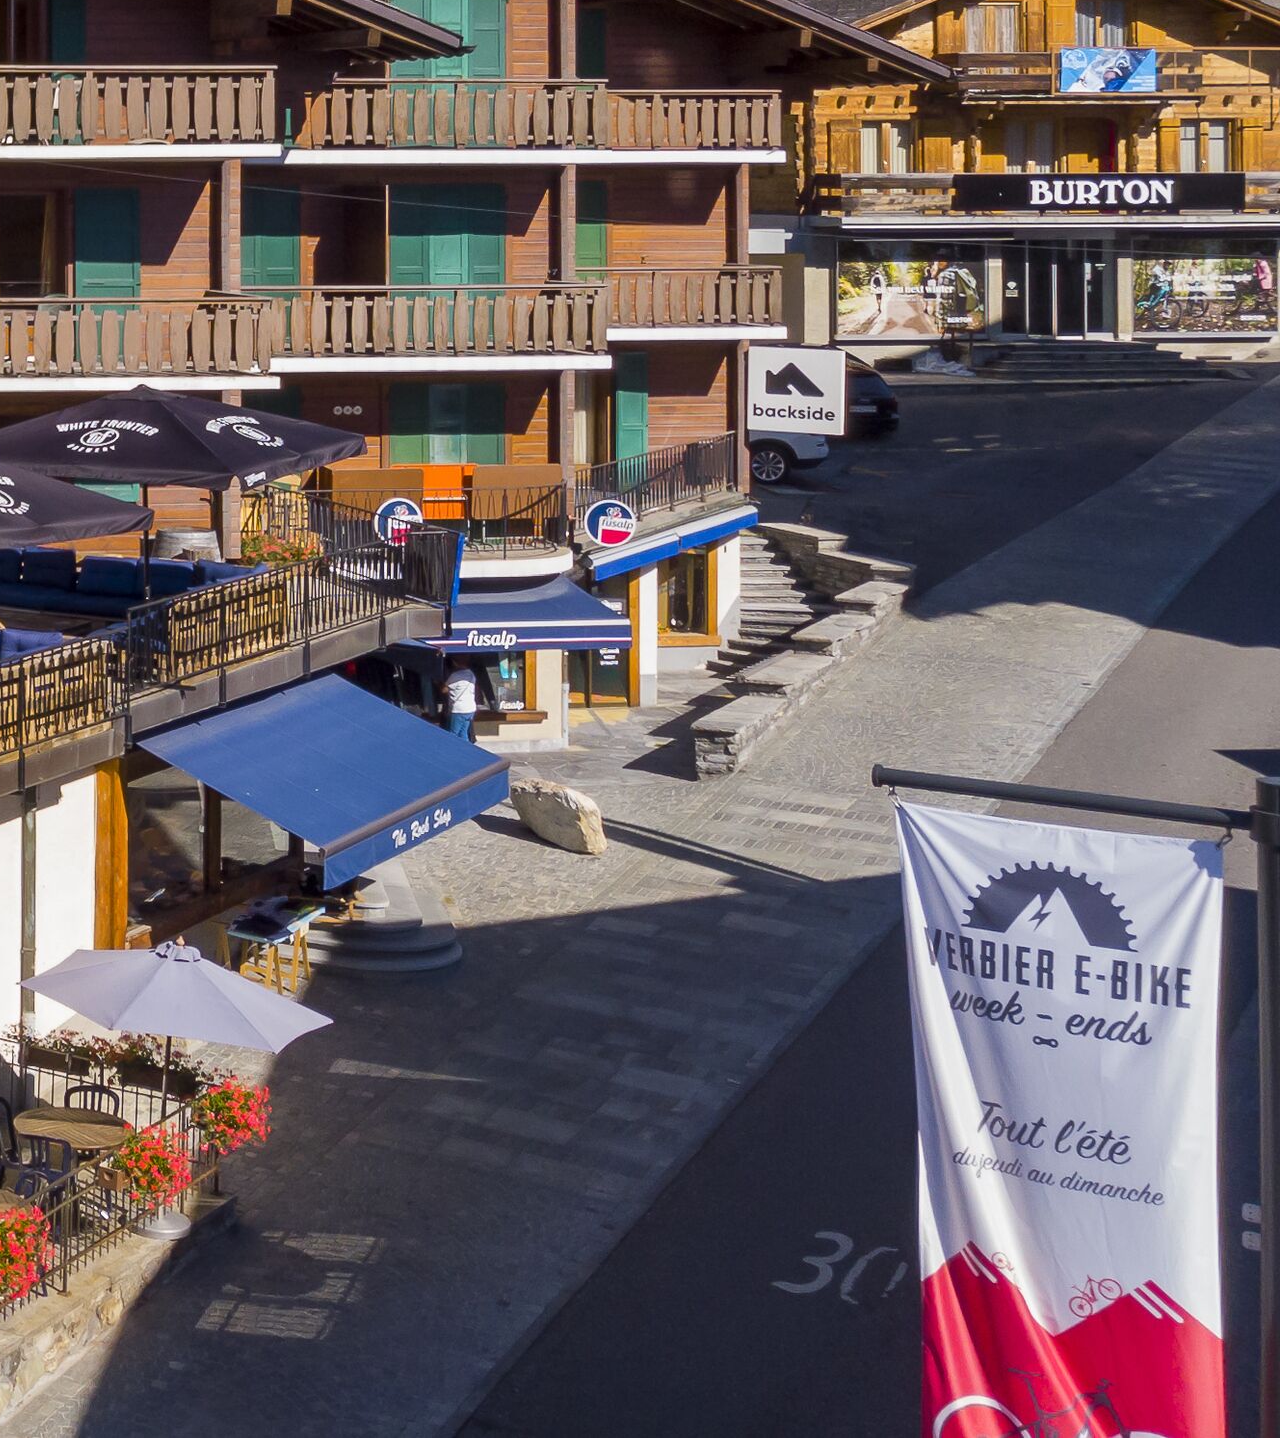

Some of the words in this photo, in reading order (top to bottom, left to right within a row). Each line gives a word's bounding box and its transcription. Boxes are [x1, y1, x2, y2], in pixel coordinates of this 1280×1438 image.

[1029, 179, 1175, 205] BURTON
[56, 420, 100, 432] WHITE
[101, 419, 159, 437] FRONTIER
[752, 403, 836, 421] backside
[601, 518, 634, 531] fusalp
[466, 629, 518, 650] fusalp
[391, 828, 407, 849] The
[410, 819, 430, 841] Rock
[433, 808, 452, 829] Shop
[924, 926, 1054, 990] VERBIER
[1074, 953, 1192, 1009] E-BIKE
[950, 989, 1026, 1025] week
[1064, 1010, 1152, 1046] ends
[977, 1100, 1048, 1149] Tout
[1054, 1119, 1132, 1165] l'été
[952, 1147, 977, 1166] du
[974, 1153, 1023, 1179] jeudi
[1027, 1168, 1056, 1186] au
[1059, 1171, 1166, 1206] dimanche
